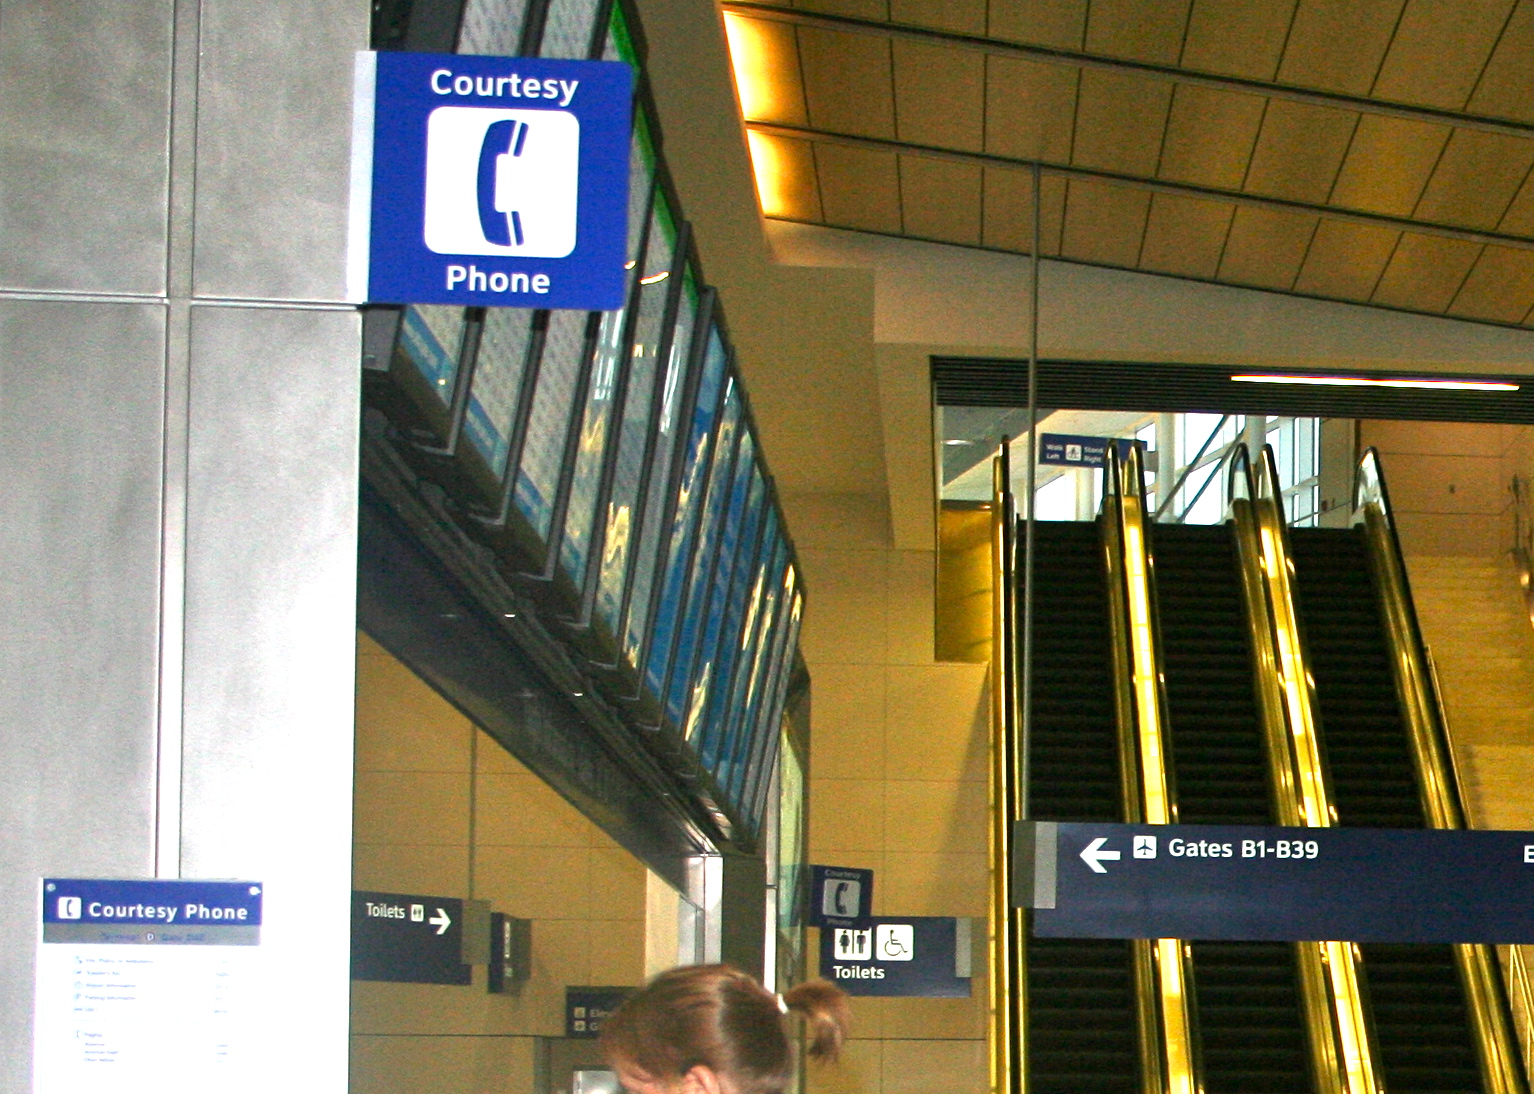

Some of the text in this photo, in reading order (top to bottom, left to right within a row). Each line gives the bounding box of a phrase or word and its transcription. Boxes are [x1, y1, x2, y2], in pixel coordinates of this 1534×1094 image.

[431, 69, 580, 107] Courtesy
[446, 264, 551, 294] Phone
[1168, 838, 1320, 860] Gates B1-B39
[89, 902, 248, 923] Courtesy Phone
[366, 902, 406, 919] Toilets
[833, 965, 886, 980] Toilets
